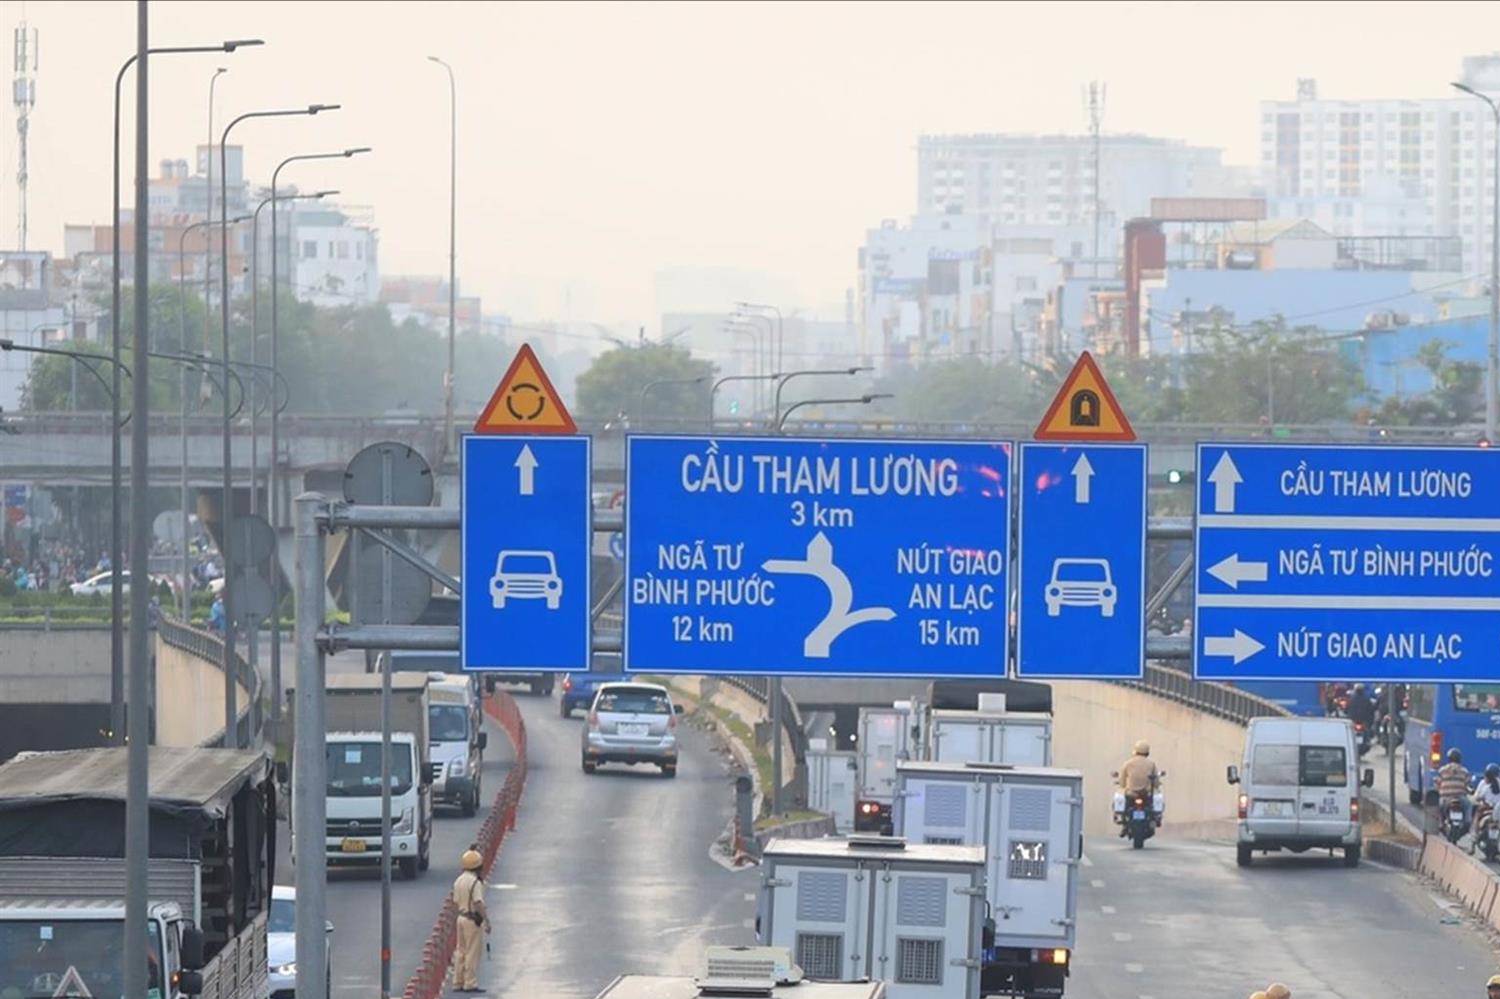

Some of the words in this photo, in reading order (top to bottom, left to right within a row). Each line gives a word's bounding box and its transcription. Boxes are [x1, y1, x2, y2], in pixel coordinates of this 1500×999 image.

[681, 440, 744, 494] CẦU
[752, 454, 842, 495] THAM
[850, 453, 959, 497] LƯƠNG
[1280, 459, 1325, 497] CẦU
[1329, 471, 1392, 497] THAM
[1397, 468, 1472, 499] LƯƠNG
[790, 502, 805, 528] 3
[812, 501, 854, 528] km
[658, 539, 707, 571] NGÃ
[712, 541, 746, 570] TƯ
[897, 541, 944, 575] NÚT
[949, 548, 1003, 576] GIAO
[1278, 543, 1325, 576] NGÃ
[1329, 548, 1359, 576] TƯ
[1363, 543, 1415, 577] BÌNH
[1419, 543, 1493, 577] PHƯỚC
[632, 573, 687, 606] BÌNH
[696, 572, 776, 606] PHƯỚC
[908, 583, 942, 609] AN
[949, 583, 994, 616] LẠC
[672, 616, 694, 643] 12
[699, 616, 734, 643] km
[919, 619, 940, 646] 15
[945, 619, 980, 646] km
[1278, 625, 1323, 658] NÚT
[1327, 632, 1378, 658] GIAO
[1383, 632, 1416, 659] AN
[1419, 632, 1463, 664] LẠC
